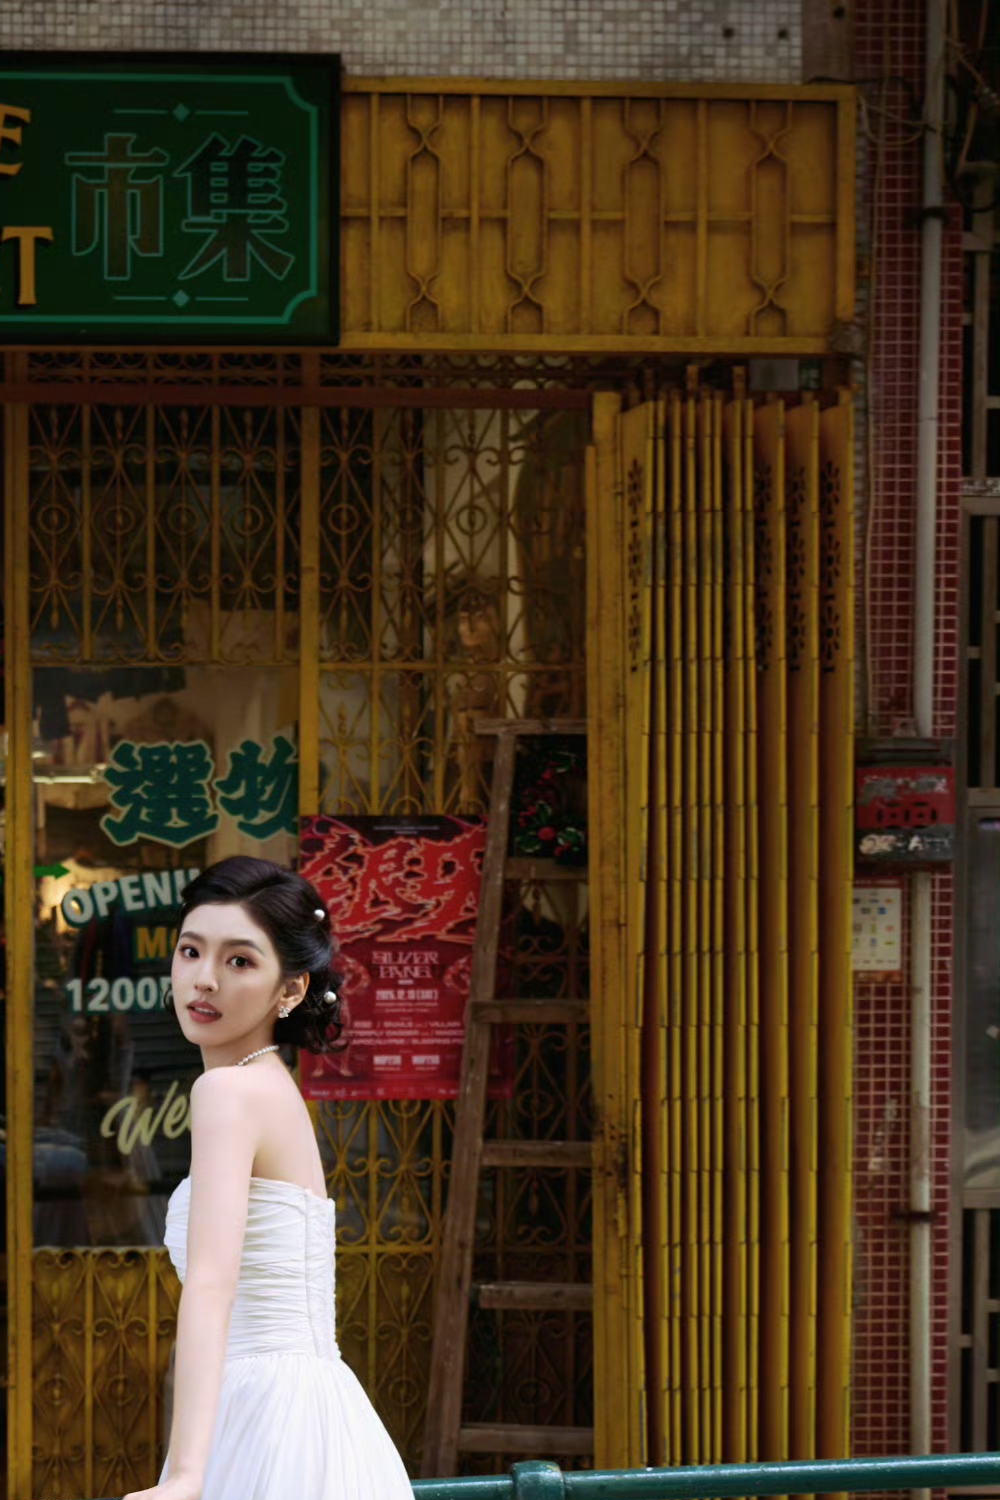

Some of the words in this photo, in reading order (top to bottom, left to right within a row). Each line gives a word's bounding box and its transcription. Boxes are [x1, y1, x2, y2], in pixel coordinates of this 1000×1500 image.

[64, 132, 296, 282] 市集
[61, 867, 200, 926] OPENI
[100, 1079, 192, 1155] We
